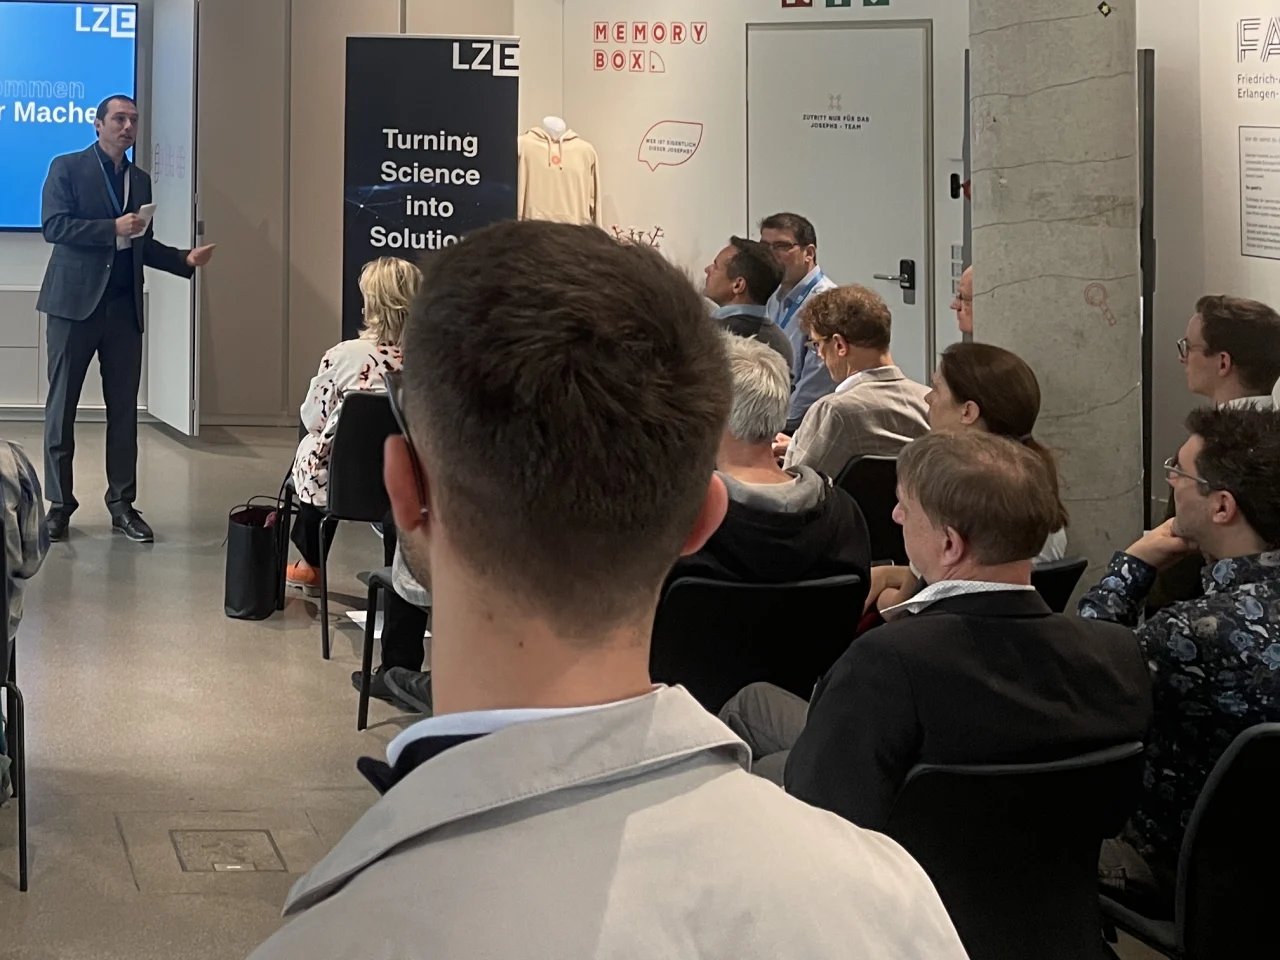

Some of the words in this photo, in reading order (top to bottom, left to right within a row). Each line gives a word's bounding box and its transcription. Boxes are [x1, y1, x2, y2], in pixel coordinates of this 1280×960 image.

[75, 4, 136, 38] LZE
[594, 22, 707, 44] MEMORY
[452, 40, 520, 76] LZE
[14, 101, 98, 124] Mache
[843, 114, 855, 122] FÜR
[382, 128, 478, 157] Turning
[380, 161, 480, 185] Science
[406, 195, 454, 217] into
[370, 226, 466, 250] Solutio
